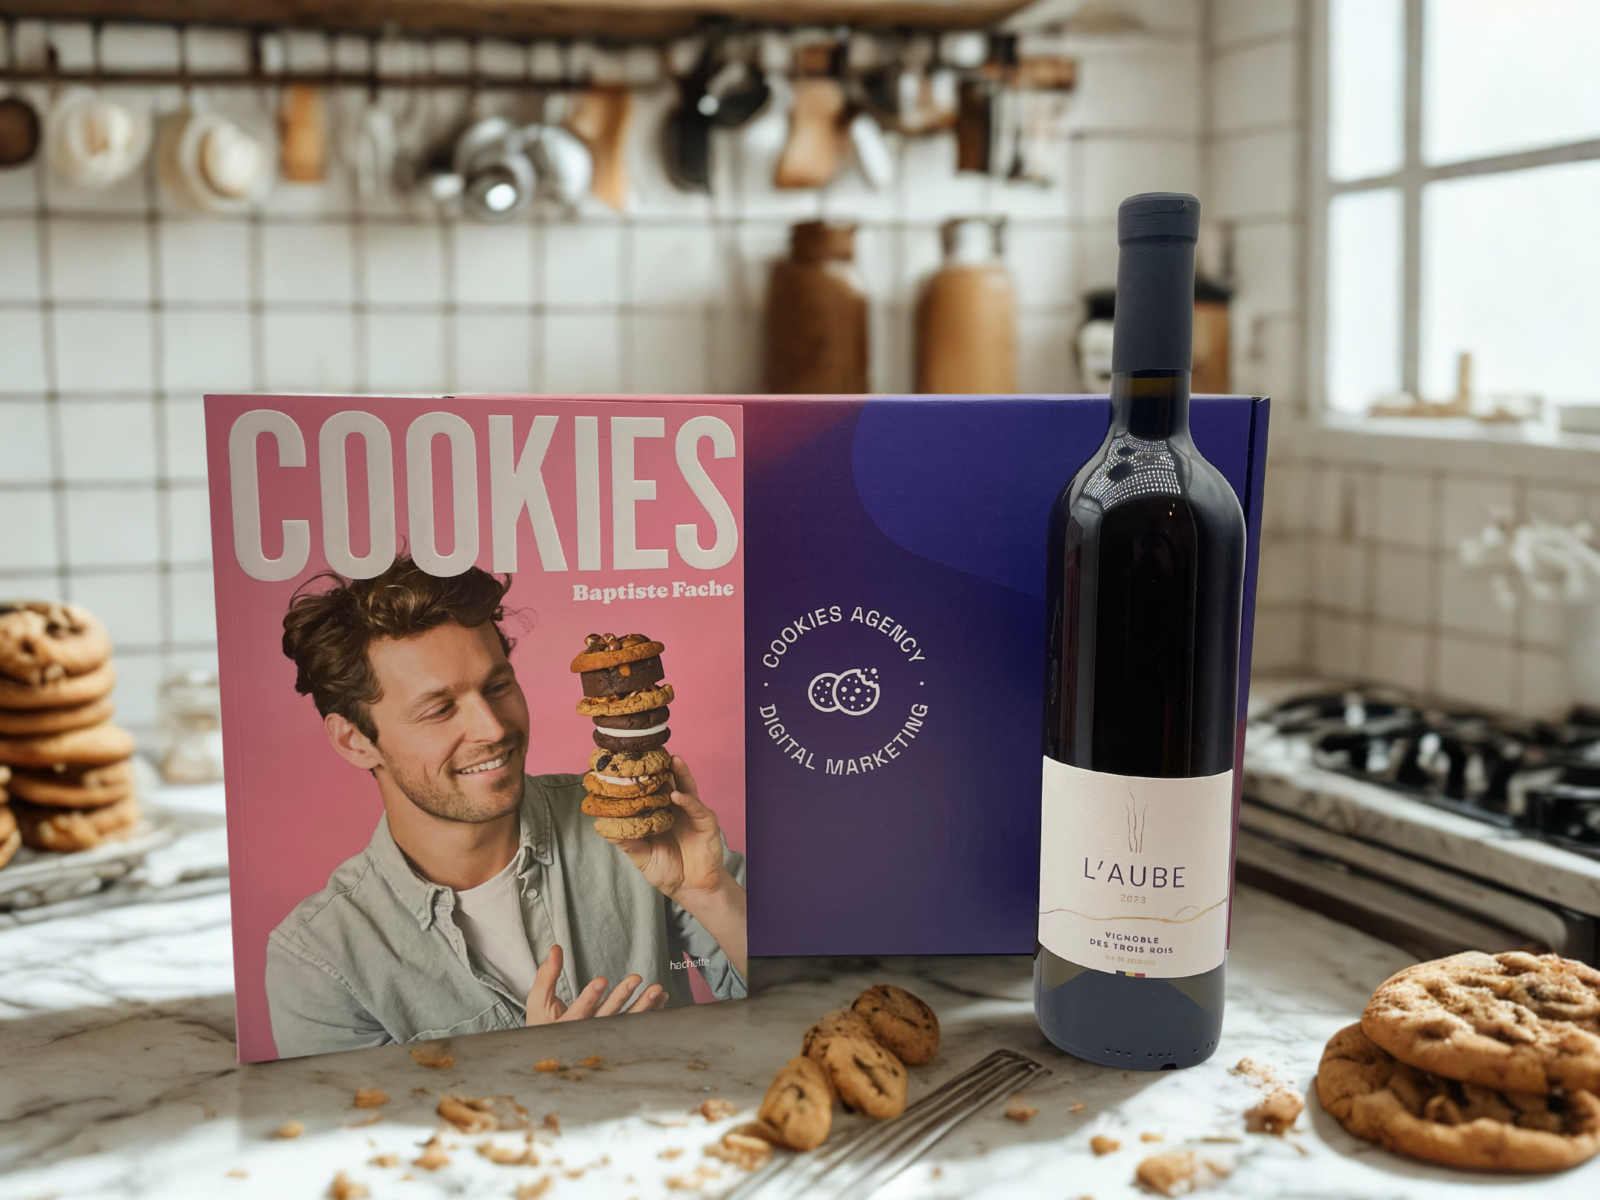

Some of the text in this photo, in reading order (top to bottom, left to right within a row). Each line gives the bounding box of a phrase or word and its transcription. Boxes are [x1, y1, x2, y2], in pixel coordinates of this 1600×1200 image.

[228, 409, 738, 582] COOKIES
[572, 580, 734, 604] Baptiste Fache
[763, 606, 926, 668] COOKIES AGENCY
[759, 703, 929, 776] DIGITAL MARKETING
[1084, 857, 1186, 889] L'AUBE
[1119, 893, 1147, 904] 2023
[1089, 938, 1109, 948] DES
[1113, 943, 1145, 953] TROIS
[1105, 931, 1160, 944] VIGNOBLE
[670, 957, 710, 970] hachette
